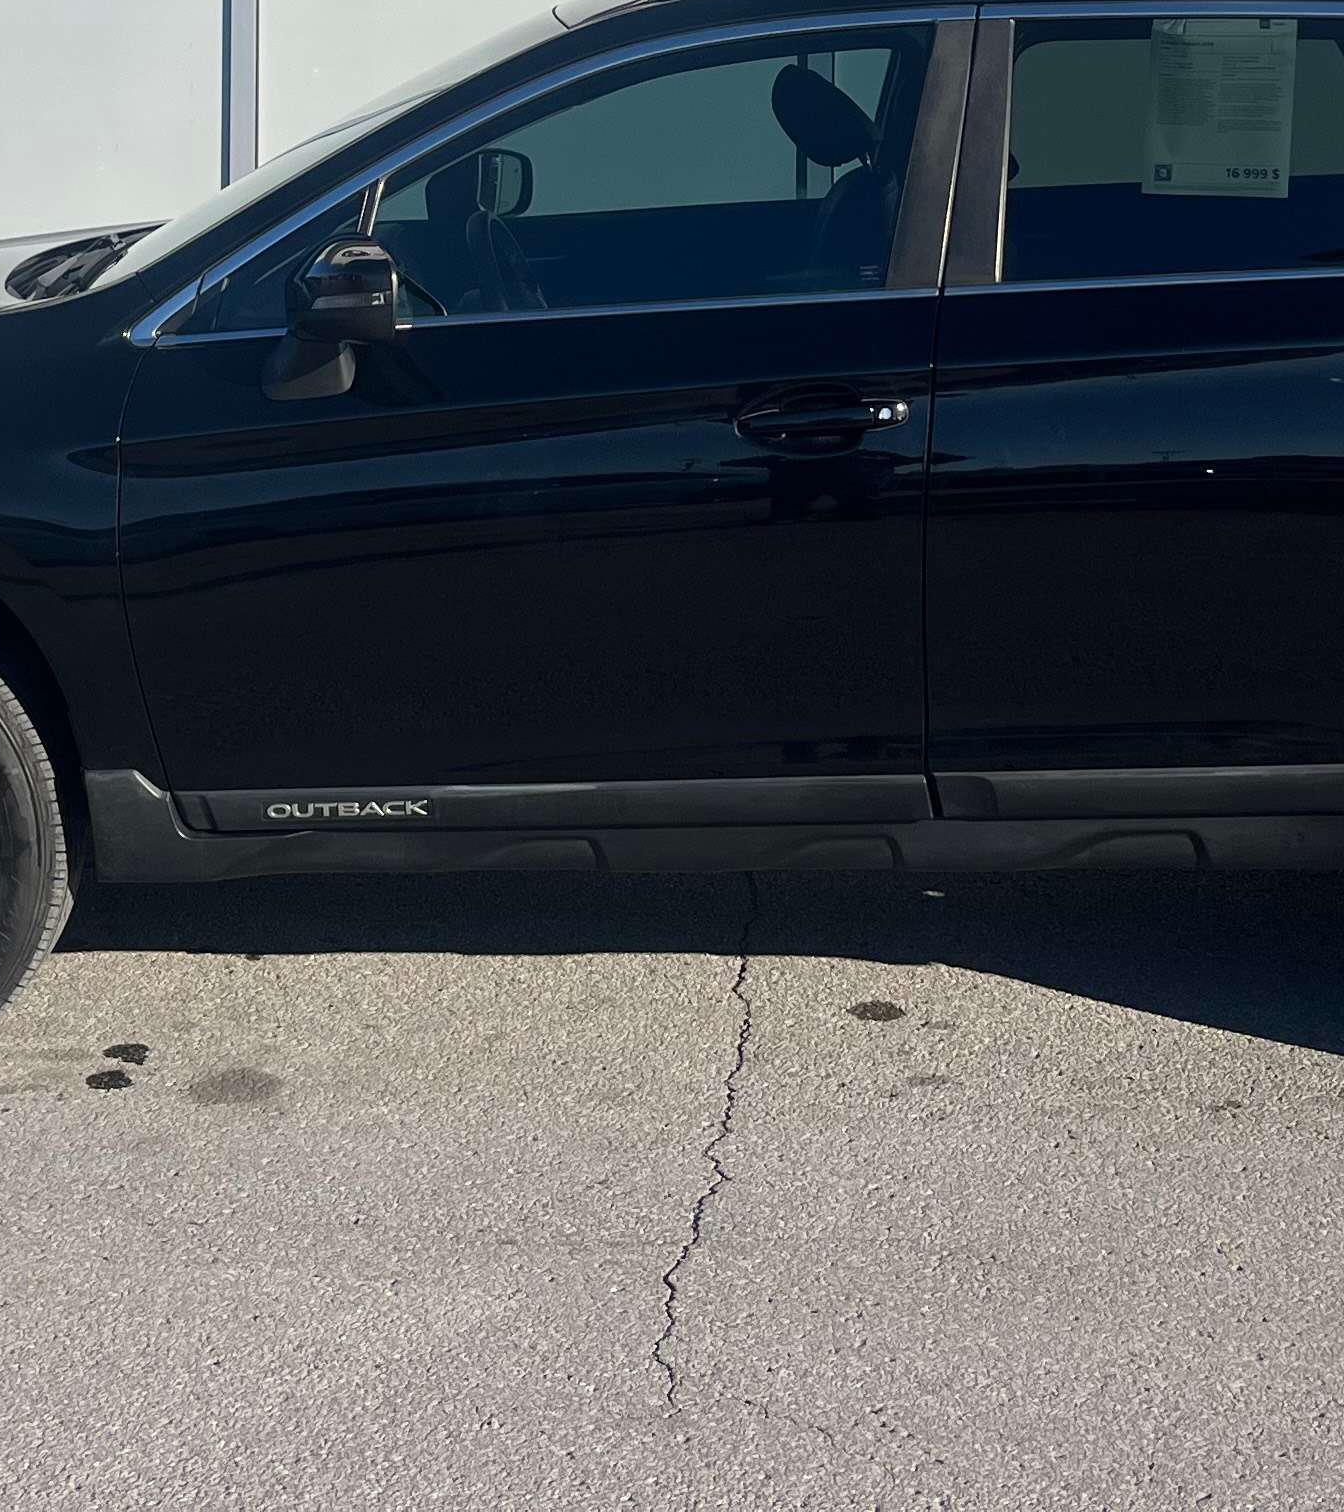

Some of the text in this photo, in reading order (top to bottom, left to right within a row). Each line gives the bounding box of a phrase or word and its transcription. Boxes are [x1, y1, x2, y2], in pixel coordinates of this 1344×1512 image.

[1225, 167, 1241, 179] 16
[1243, 167, 1268, 180] 999
[266, 799, 429, 819] OUTBACK
